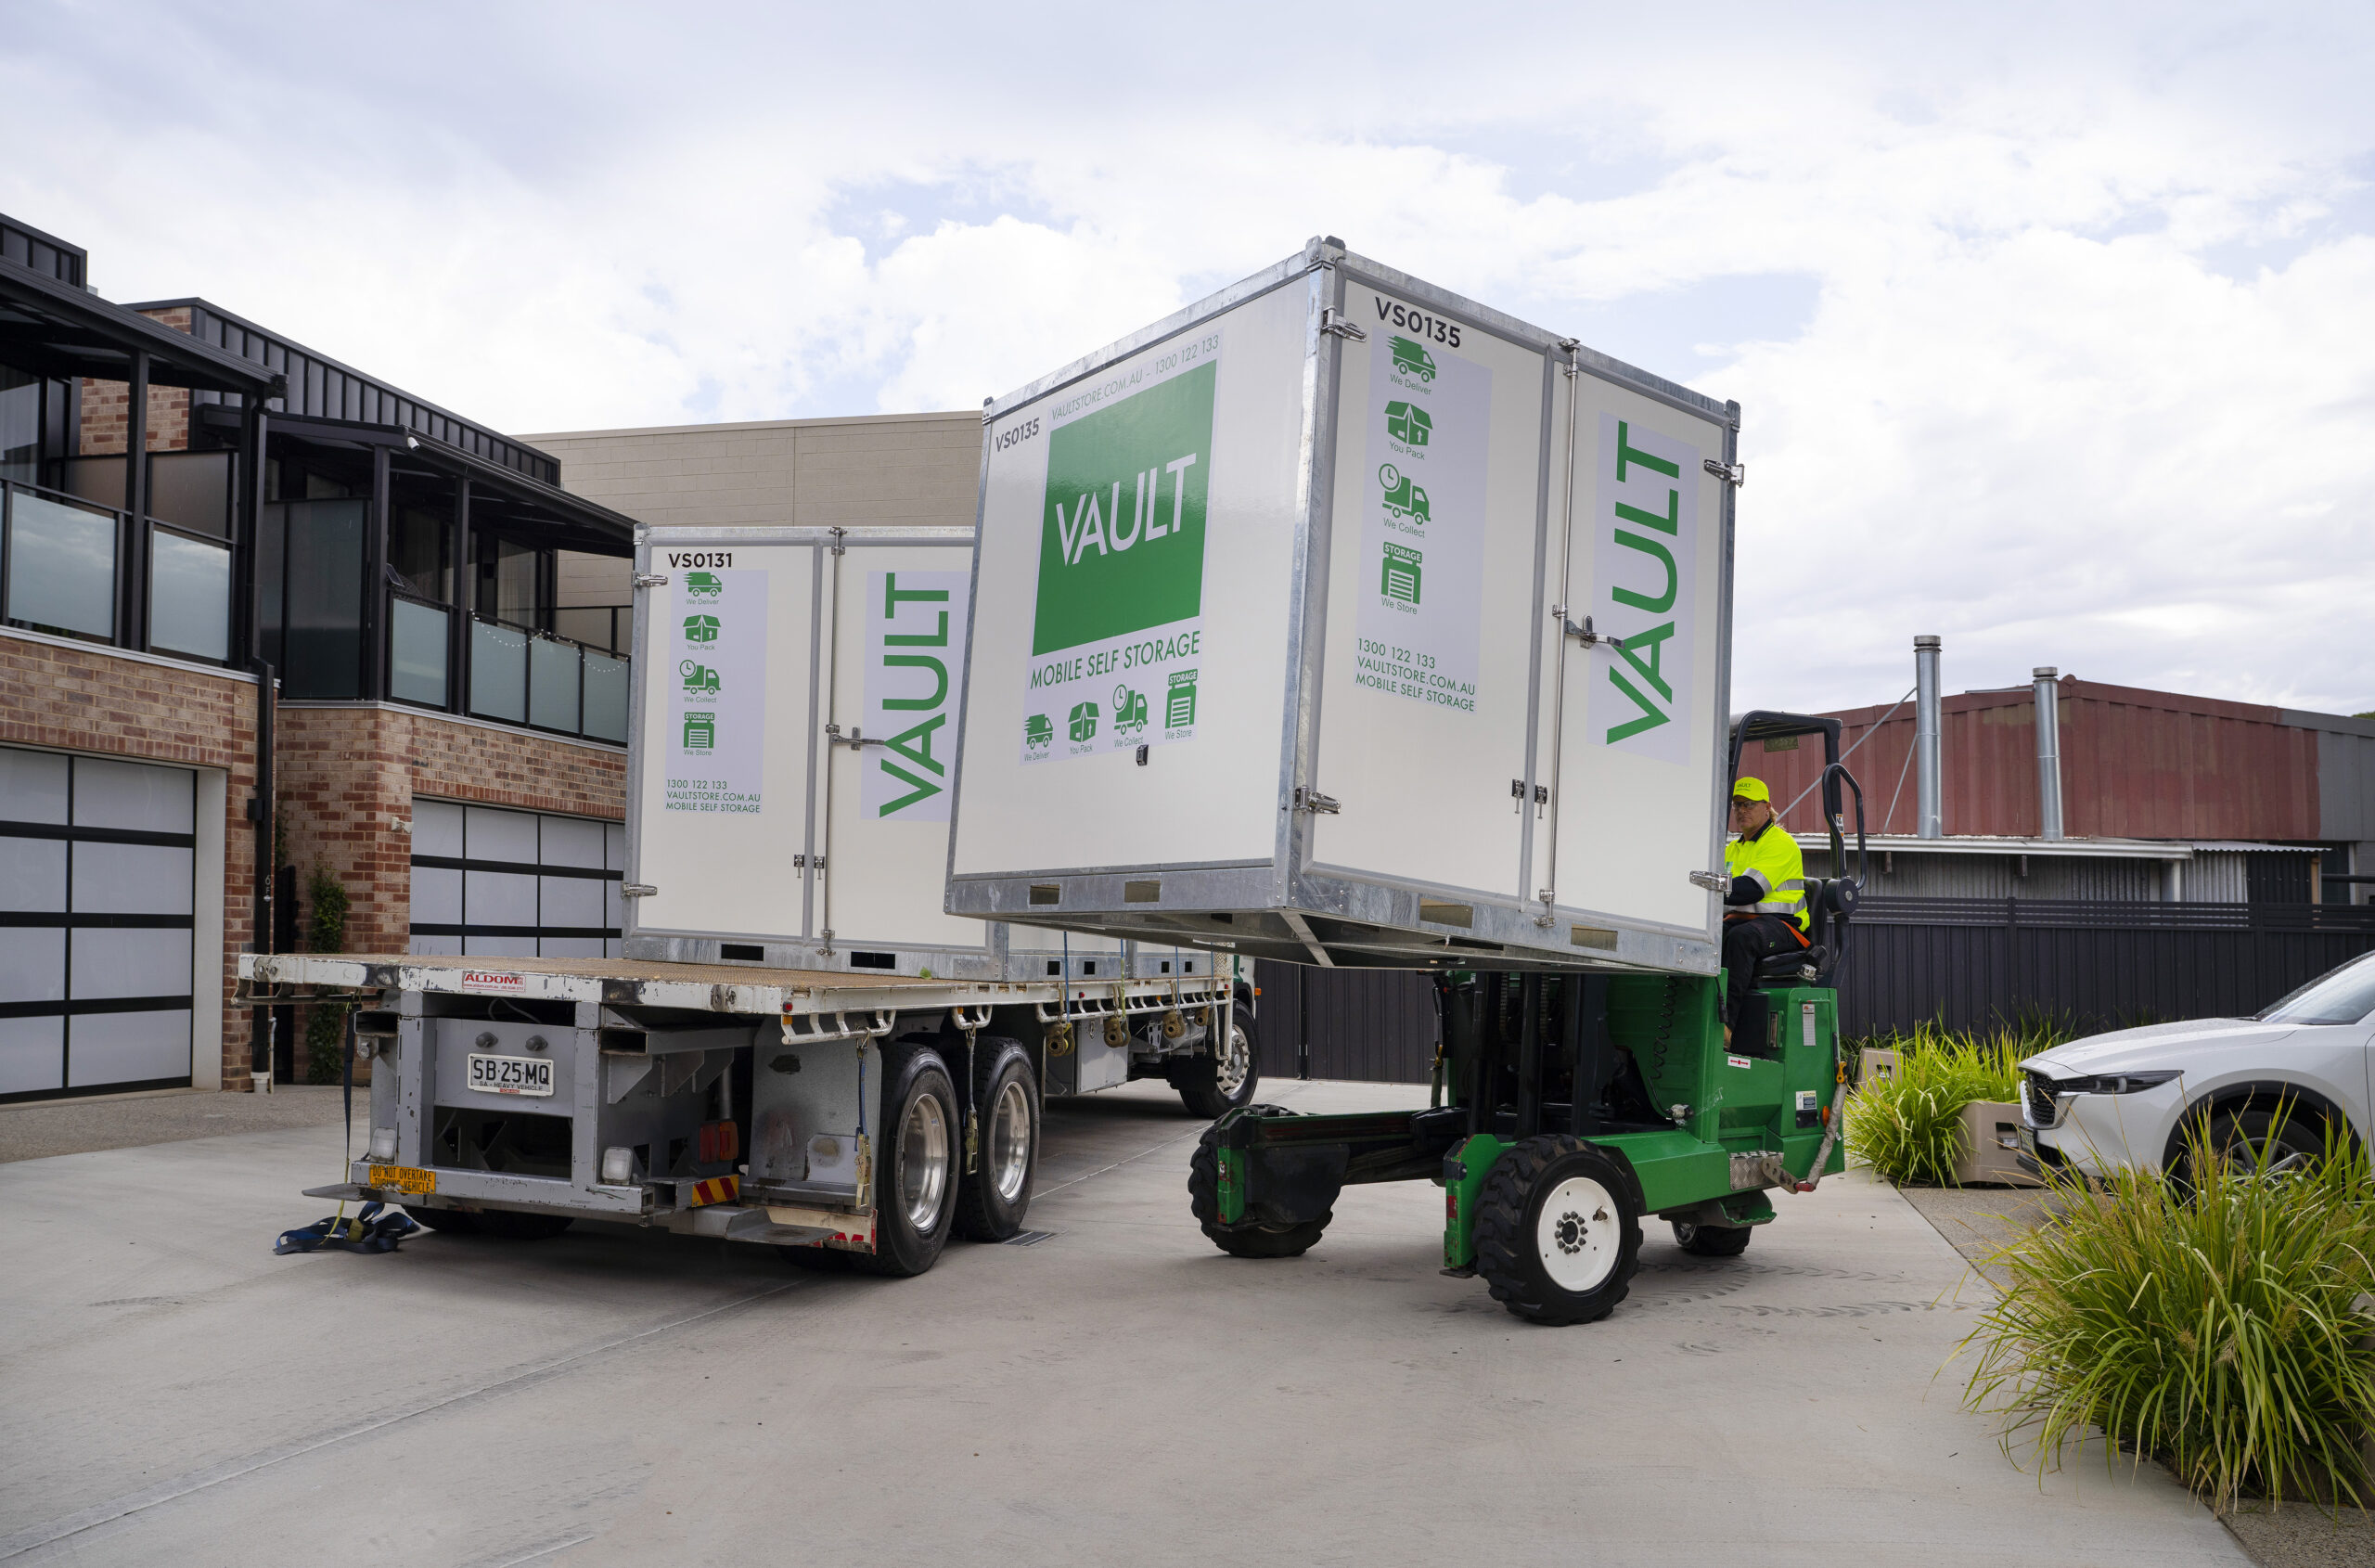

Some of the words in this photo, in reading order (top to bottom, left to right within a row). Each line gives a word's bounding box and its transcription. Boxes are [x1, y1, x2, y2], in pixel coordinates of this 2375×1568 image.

[1052, 368, 1143, 420] VAULTSTORE.COM.AU
[1155, 353, 1177, 375] 1300
[1181, 344, 1198, 364] 122
[1202, 334, 1219, 353] 133
[1390, 374, 1403, 385] We
[1405, 379, 1431, 395] Deliver
[1389, 441, 1404, 454] You
[1406, 446, 1425, 460] Pack
[1056, 452, 1197, 567] VAULT
[1383, 517, 1396, 530] We
[1398, 521, 1425, 539] Collect
[1384, 544, 1422, 562] STORAGE
[1606, 419, 1680, 745] VAULT
[1380, 597, 1394, 609] We
[1396, 600, 1418, 615] Store
[1030, 657, 1083, 689] MOBILE
[1086, 649, 1119, 677] SELF
[1123, 630, 1200, 669] STORAGE
[1358, 637, 1386, 656] 1300
[1392, 647, 1410, 663] 122
[1417, 653, 1435, 669] 133
[1168, 670, 1198, 686] STORAGE
[1357, 655, 1475, 696] VAULTSTORE.COM.AU
[879, 572, 949, 817] VAULT
[1355, 673, 1397, 693] MOBILE
[1400, 683, 1424, 699] SELF
[1426, 688, 1475, 712] STORAGE
[1113, 739, 1123, 748] We
[1123, 736, 1144, 747] Collect
[1164, 731, 1175, 739] We
[1175, 728, 1192, 739] Store
[1024, 752, 1033, 762] We
[1033, 751, 1050, 760] Deliver
[1069, 746, 1079, 755] You
[1080, 743, 1093, 753] Pack
[666, 778, 688, 789] 1300
[692, 779, 708, 789] 122
[712, 780, 727, 790] 133
[666, 790, 761, 803] VAULTSTORE.COM.AU
[665, 802, 698, 811] MOBILE
[700, 803, 718, 812] SELF
[720, 803, 761, 813] STORAGE
[464, 973, 518, 985] ALDOM
[373, 1165, 382, 1176] DO
[385, 1166, 396, 1177] NOT
[399, 1168, 432, 1182] OVERTAKE
[404, 1181, 430, 1194] VEHICLE
